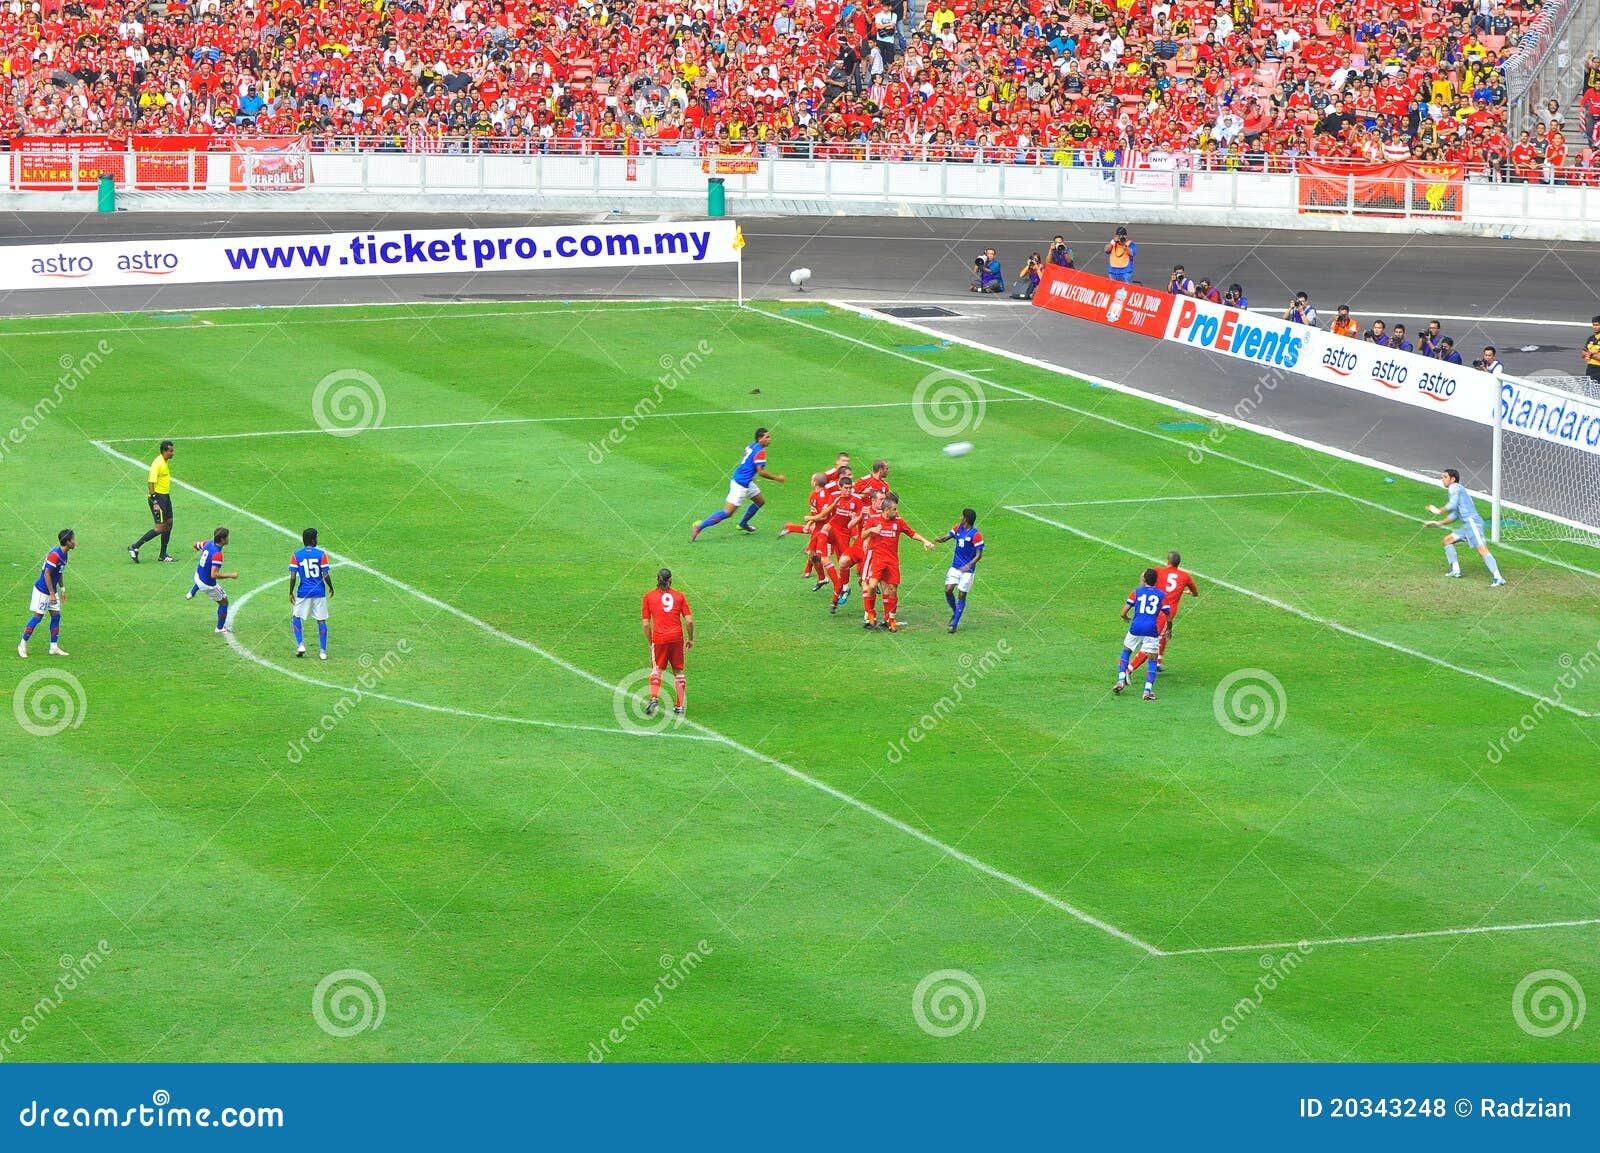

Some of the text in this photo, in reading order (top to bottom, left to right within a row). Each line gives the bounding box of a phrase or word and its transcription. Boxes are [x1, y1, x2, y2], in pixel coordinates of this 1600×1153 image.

[293, 168, 303, 181] FC
[32, 252, 93, 275] astro
[117, 250, 178, 272] astro
[1127, 291, 1161, 312] ASIA TOUR
[1129, 310, 1147, 327] 2011
[1322, 347, 1357, 371] astro
[1372, 358, 1407, 384] astro
[1418, 371, 1456, 397] astro
[299, 558, 320, 579] 15
[1165, 572, 1179, 592] 5
[661, 592, 675, 613] 9
[1137, 593, 1160, 615] 13
